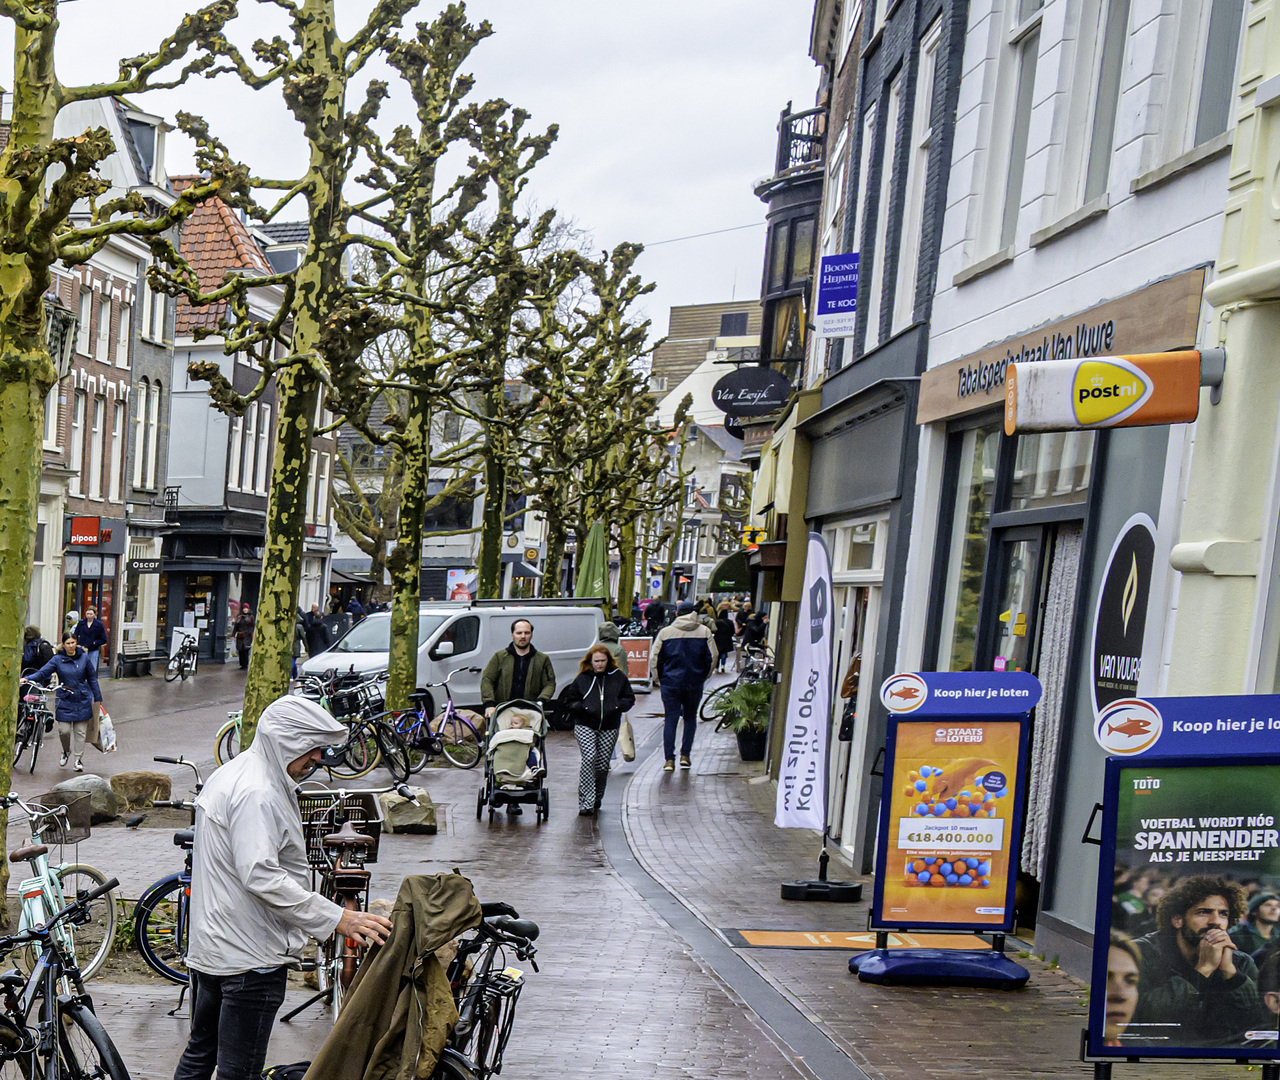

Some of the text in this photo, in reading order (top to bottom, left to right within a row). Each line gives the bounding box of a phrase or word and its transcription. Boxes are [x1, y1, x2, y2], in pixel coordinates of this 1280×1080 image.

[1052, 332, 1074, 361] Van
[1076, 320, 1116, 357] Vuure
[717, 388, 734, 400] Van
[1079, 382, 1137, 403] postnl
[72, 534, 98, 543] pipoos
[934, 688, 1029, 699] Koop hier je loten
[948, 728, 983, 736] STAATS
[1172, 721, 1212, 734] Koop
[1216, 718, 1247, 730] hier
[1248, 718, 1264, 732] je
[1133, 778, 1161, 790] TOTO
[1140, 814, 1274, 829] VOETBAL WORDT NÓG
[906, 832, 994, 843] €18.400.000
[1134, 830, 1279, 850] SPANNENDER
[1149, 852, 1173, 862] ALS
[1176, 851, 1190, 862] JE
